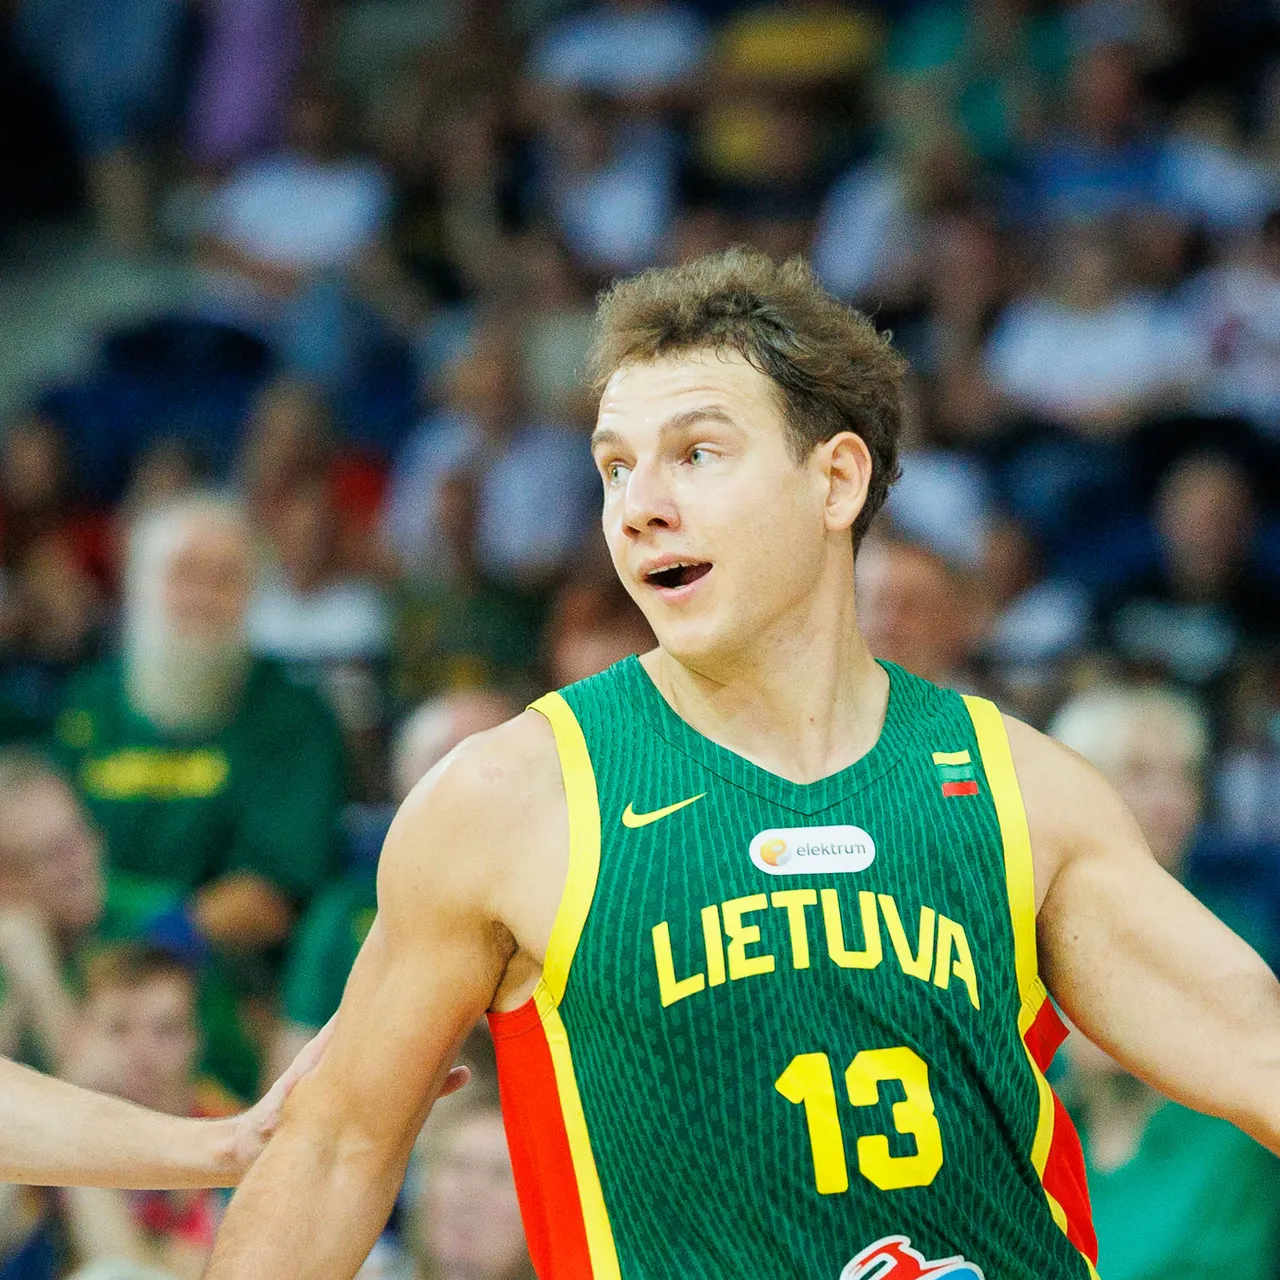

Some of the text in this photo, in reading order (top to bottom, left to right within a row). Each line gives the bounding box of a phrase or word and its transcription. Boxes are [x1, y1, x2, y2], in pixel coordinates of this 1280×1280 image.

[796, 843, 866, 856] elektrum
[652, 888, 980, 1010] LIETUVA
[775, 1046, 944, 1195] 13
